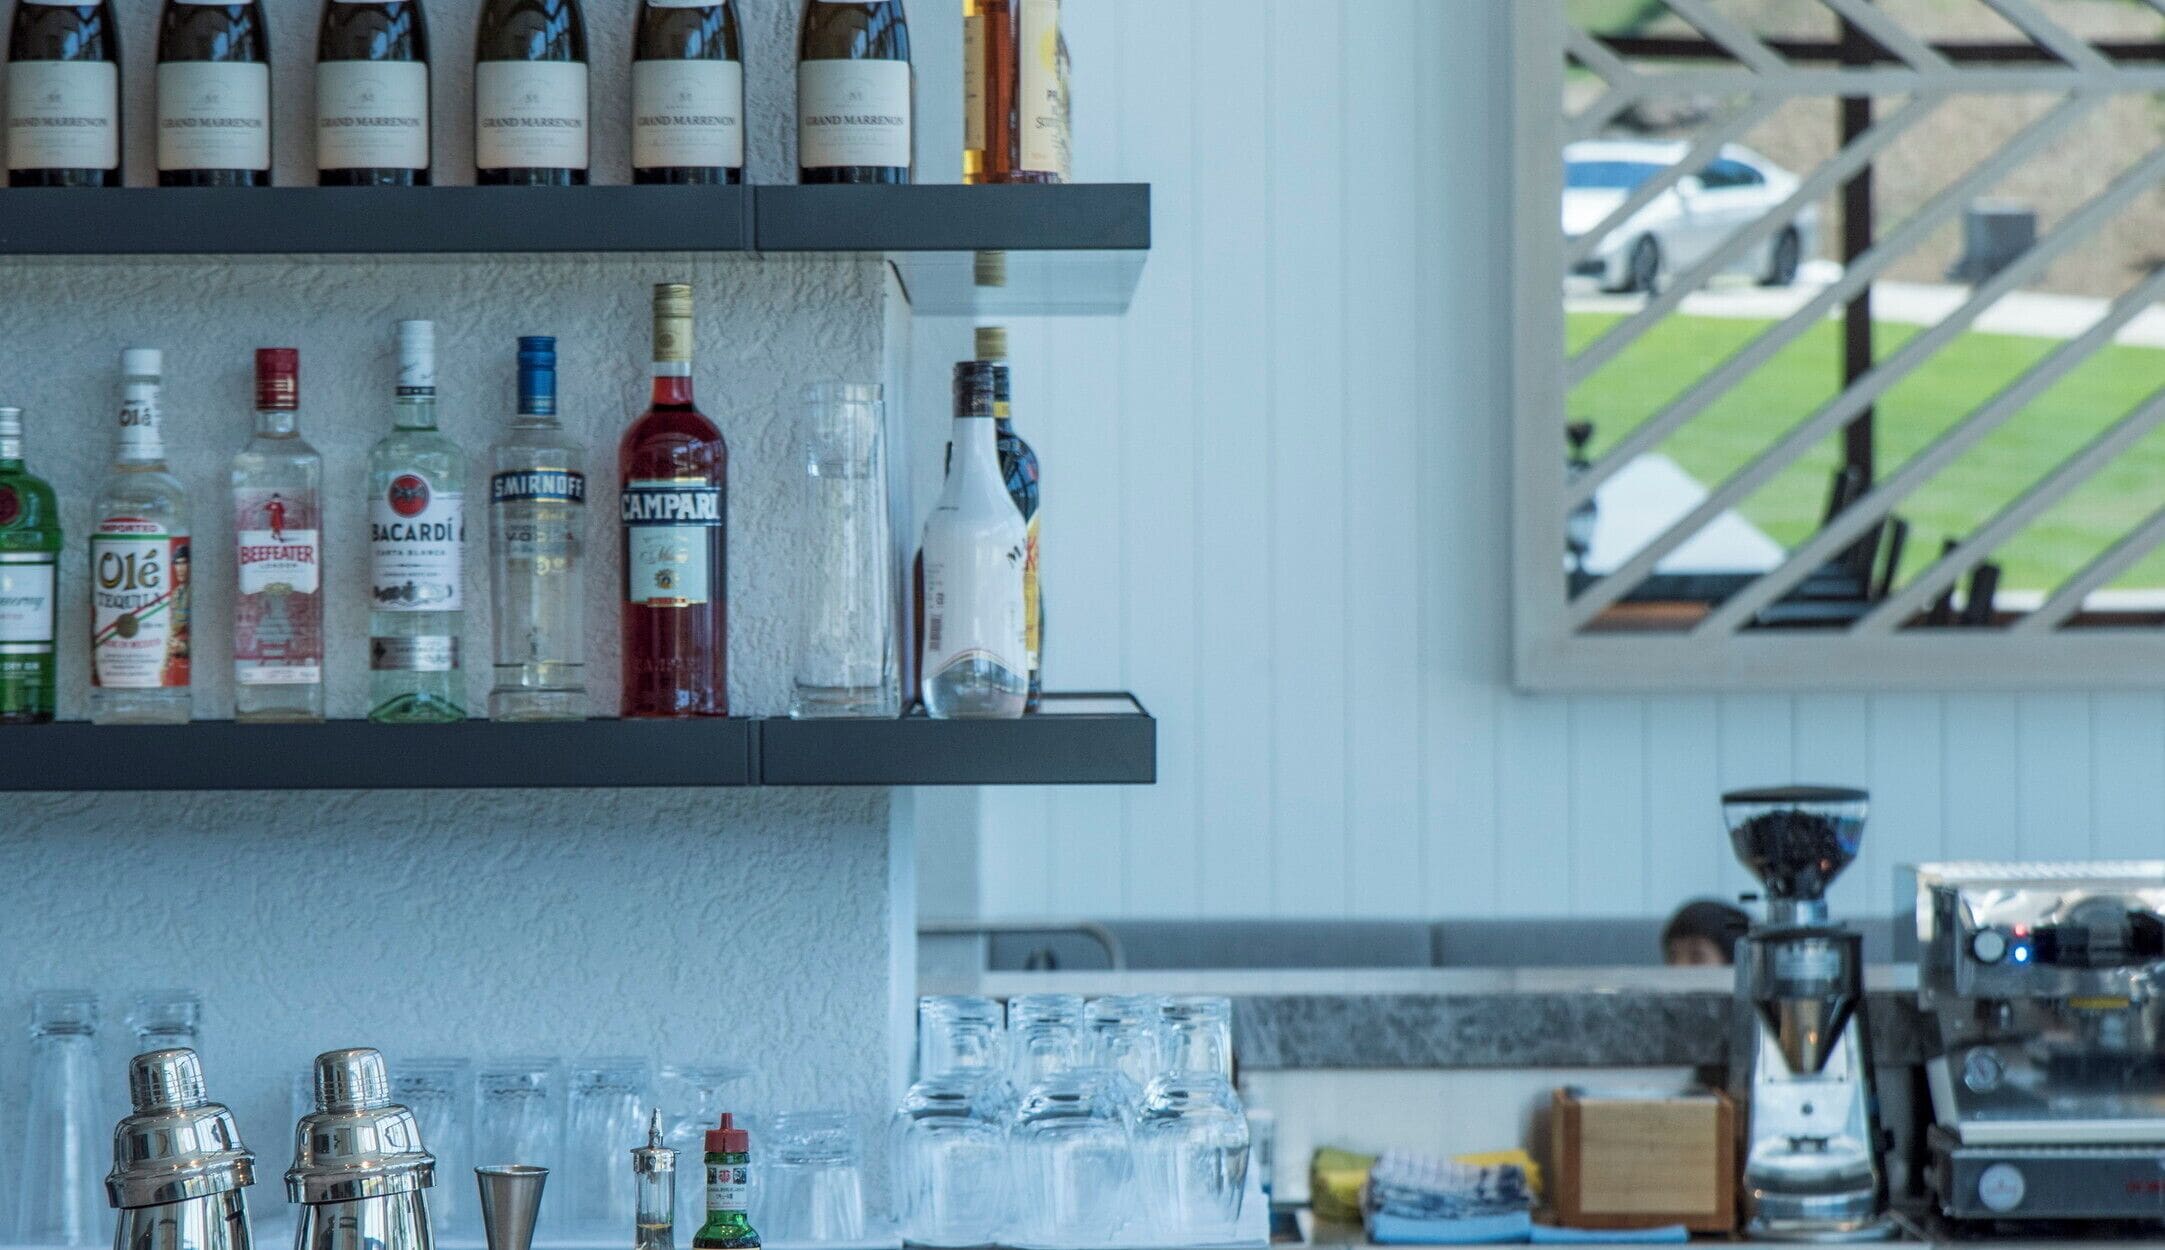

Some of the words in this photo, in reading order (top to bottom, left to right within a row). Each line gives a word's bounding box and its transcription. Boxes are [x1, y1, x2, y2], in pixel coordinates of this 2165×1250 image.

[480, 118, 519, 128] GRAND
[636, 116, 671, 127] GRAND
[673, 116, 738, 127] MARRENON
[804, 116, 842, 126] GRAND
[844, 116, 904, 126] MARRENON
[494, 475, 584, 498] SMIRNOFF
[620, 493, 720, 521] CAMPARI
[372, 517, 453, 542] BACARDÍ
[240, 545, 315, 565] BEEFEATER
[99, 548, 161, 591] Olé
[98, 592, 161, 610] TEQUILA
